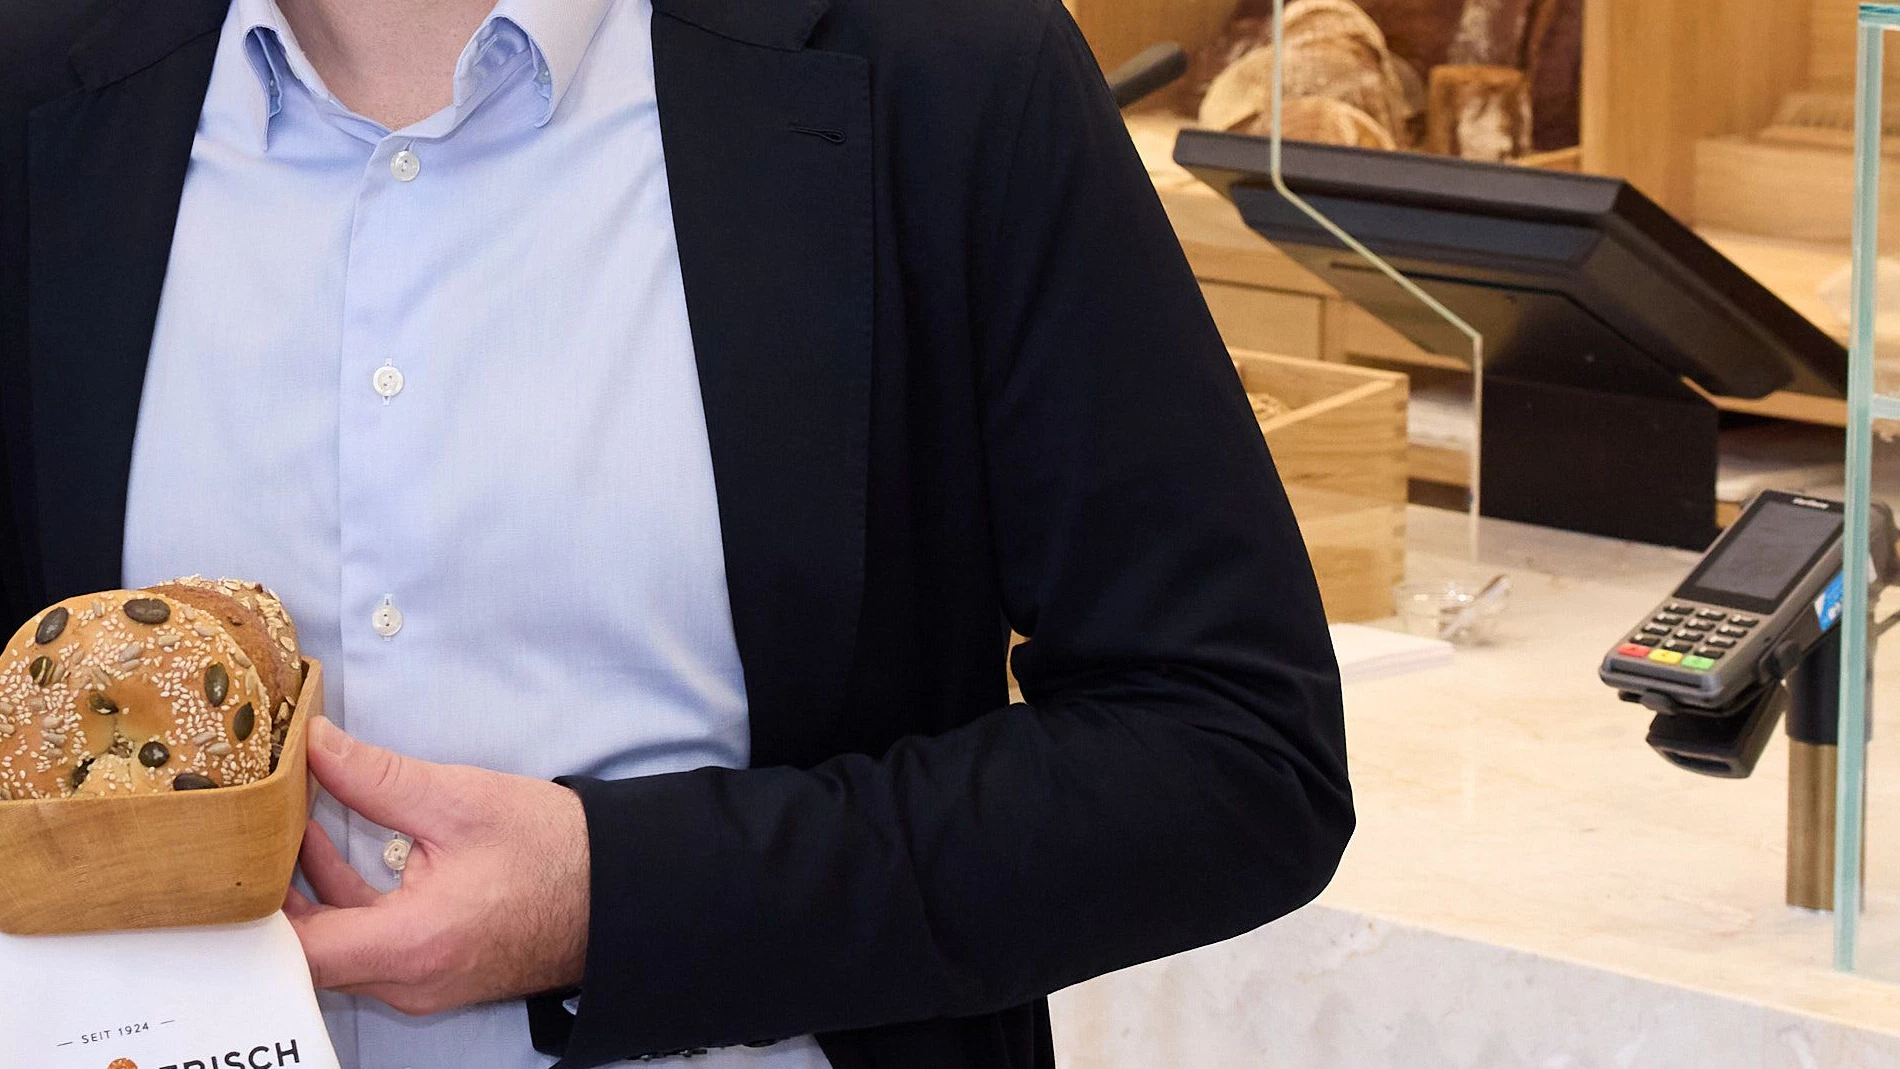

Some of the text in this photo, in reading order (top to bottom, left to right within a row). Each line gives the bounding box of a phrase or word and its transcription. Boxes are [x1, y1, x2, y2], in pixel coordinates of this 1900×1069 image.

[81, 1022, 150, 1044] SEIT 1924
[159, 1038, 300, 1069] ISCH
